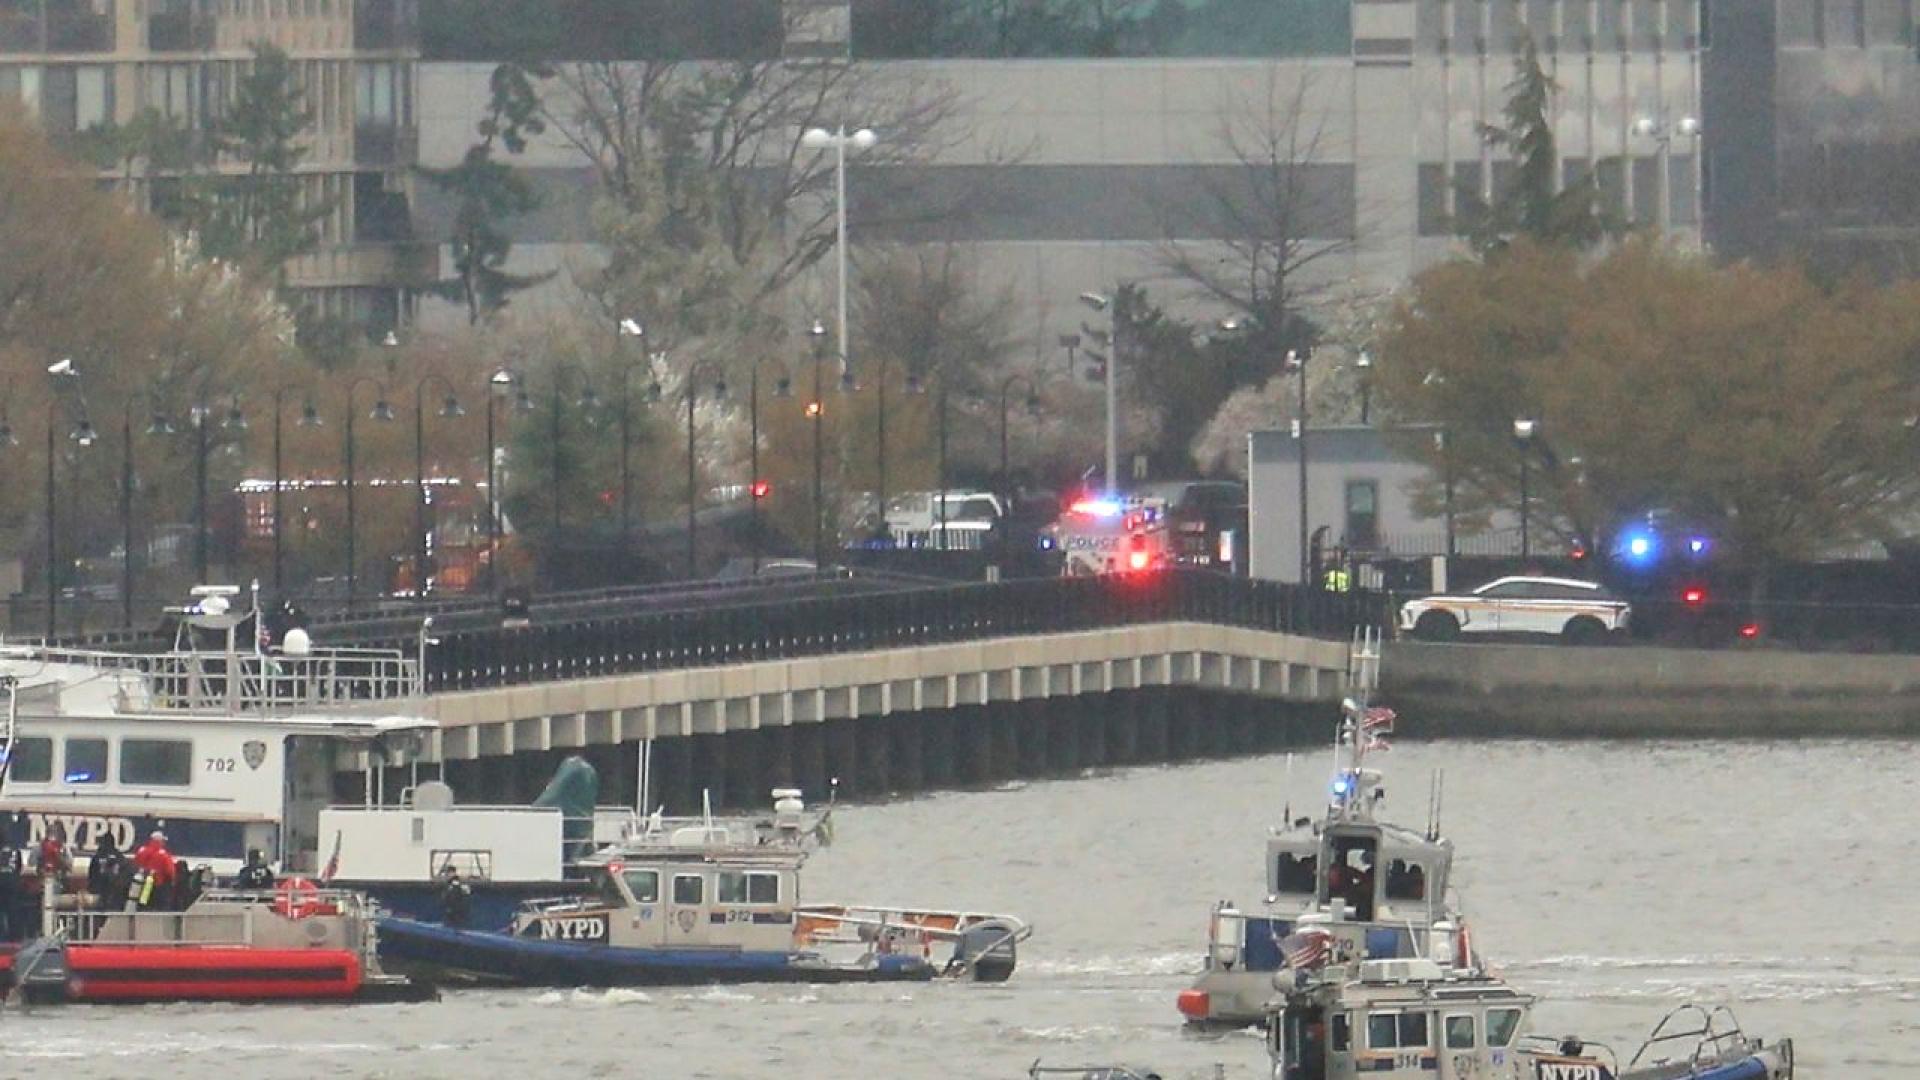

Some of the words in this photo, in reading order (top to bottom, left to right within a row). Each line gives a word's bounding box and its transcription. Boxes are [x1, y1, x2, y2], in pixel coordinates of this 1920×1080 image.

[205, 758, 235, 772] 702
[27, 813, 136, 853] NYPD
[540, 918, 604, 940] NYPD
[1540, 1064, 1600, 1080] NYPD
